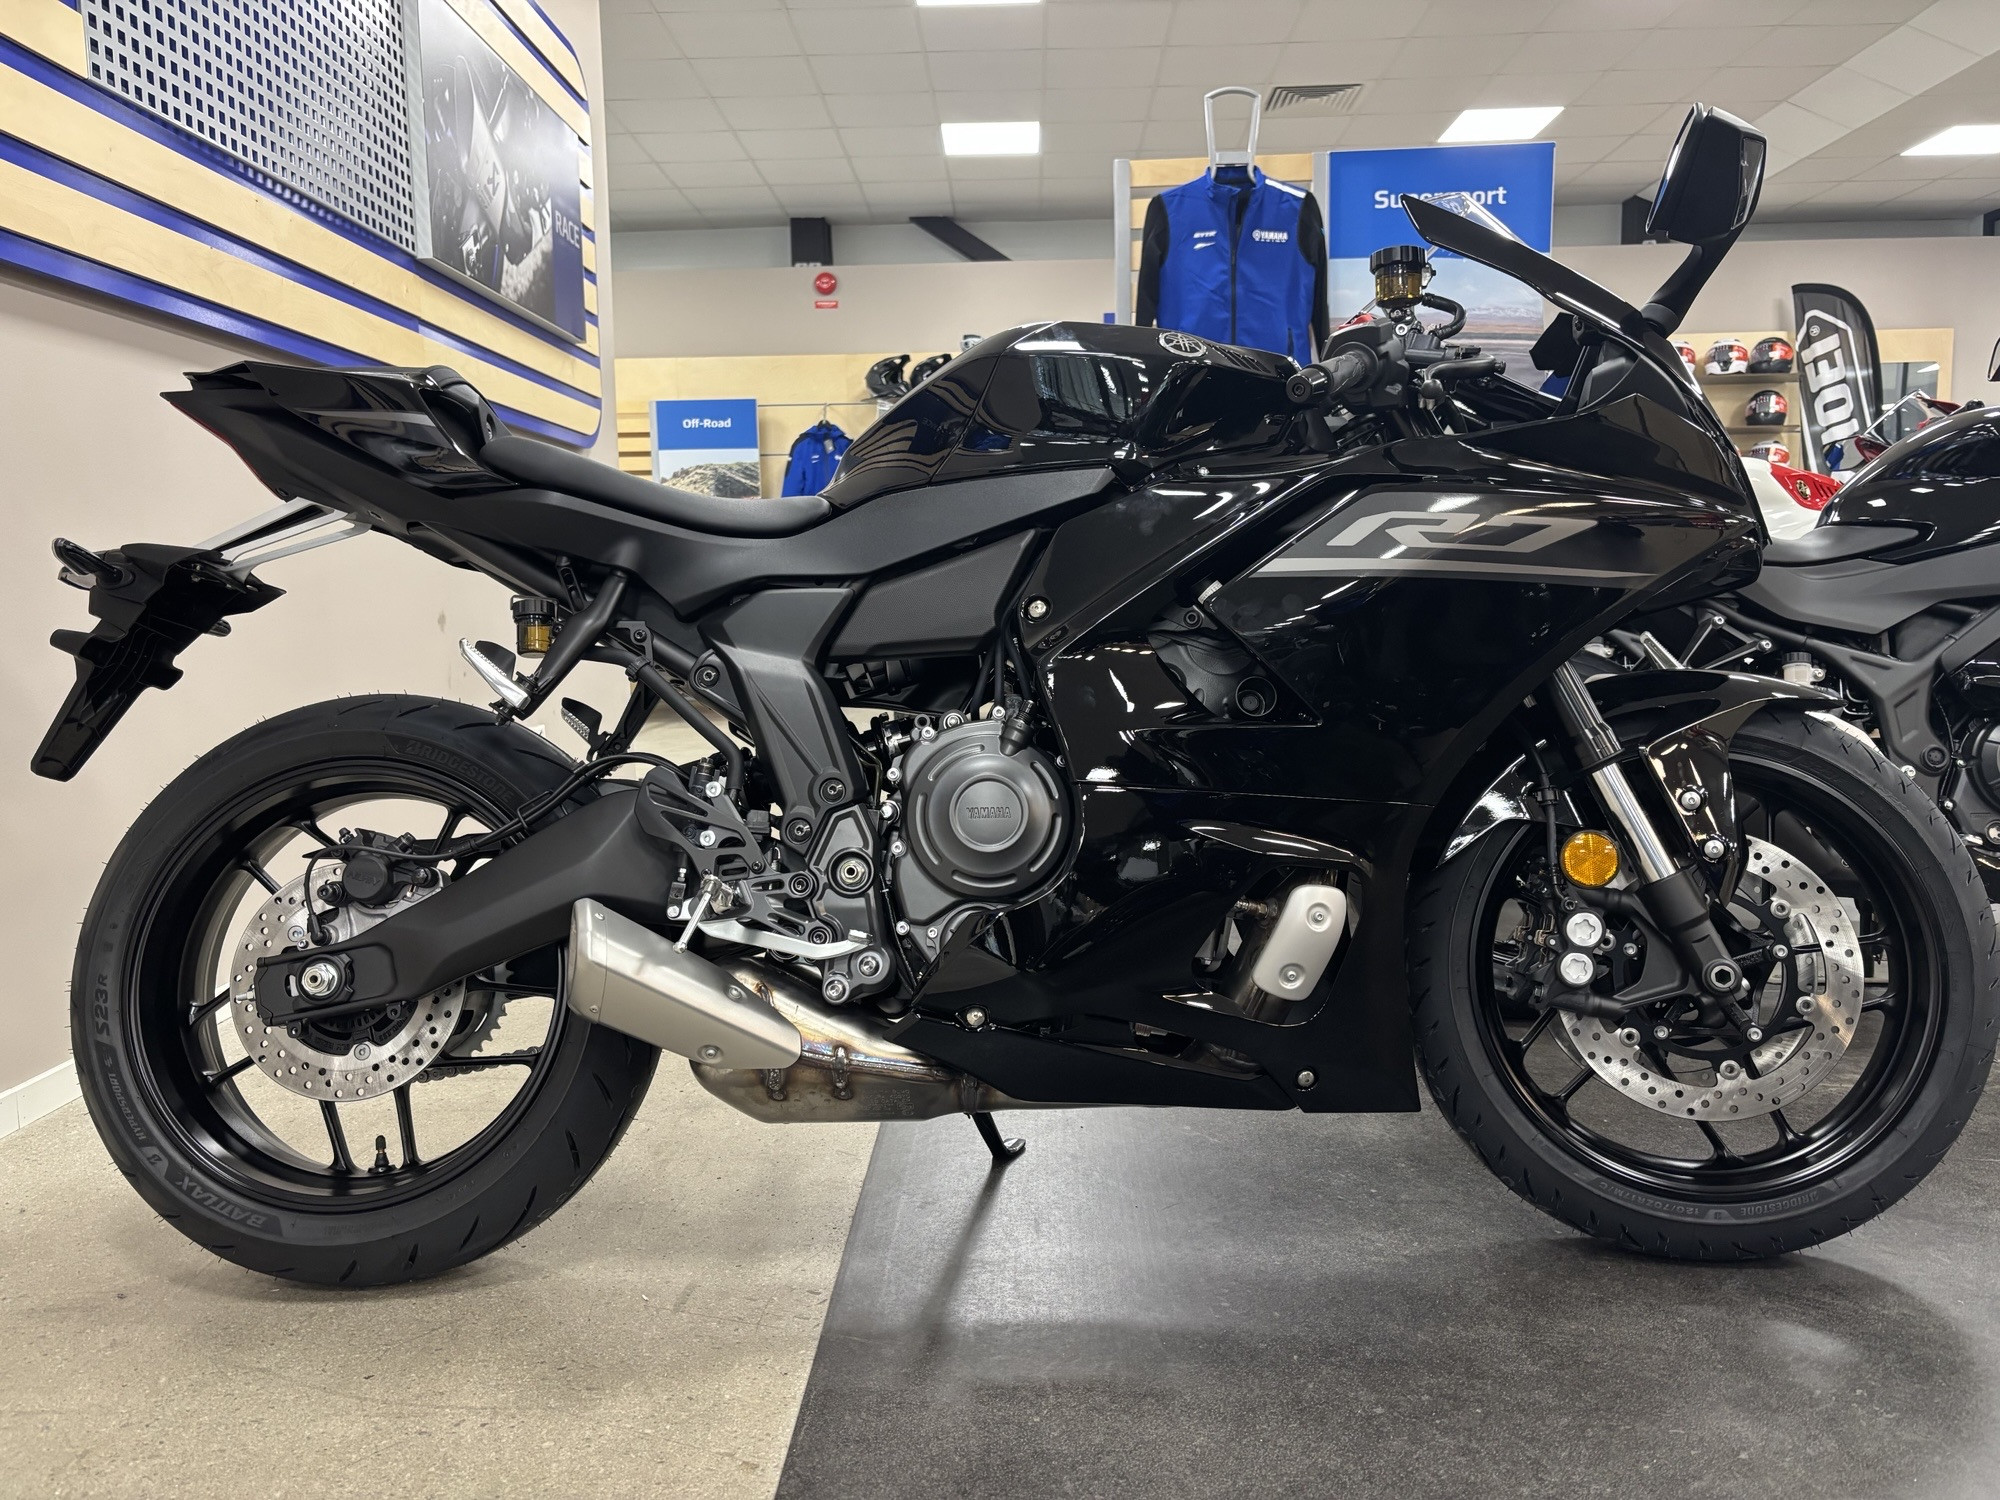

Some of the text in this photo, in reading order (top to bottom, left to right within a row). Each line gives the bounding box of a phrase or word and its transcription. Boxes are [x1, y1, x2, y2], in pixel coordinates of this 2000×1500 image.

[1374, 186, 1507, 209] Suort
[555, 209, 582, 249] RACE
[682, 417, 732, 430] Off-Road
[1326, 509, 1599, 553] R7
[404, 739, 515, 801] BRIDGESTONE
[965, 806, 1012, 819] YAMAHA
[94, 973, 111, 1038] S23R
[108, 1072, 148, 1141] HYPERSPORT
[174, 1175, 268, 1229] BATTLAX
[1740, 1190, 1820, 1216] BRIDGESTONE
